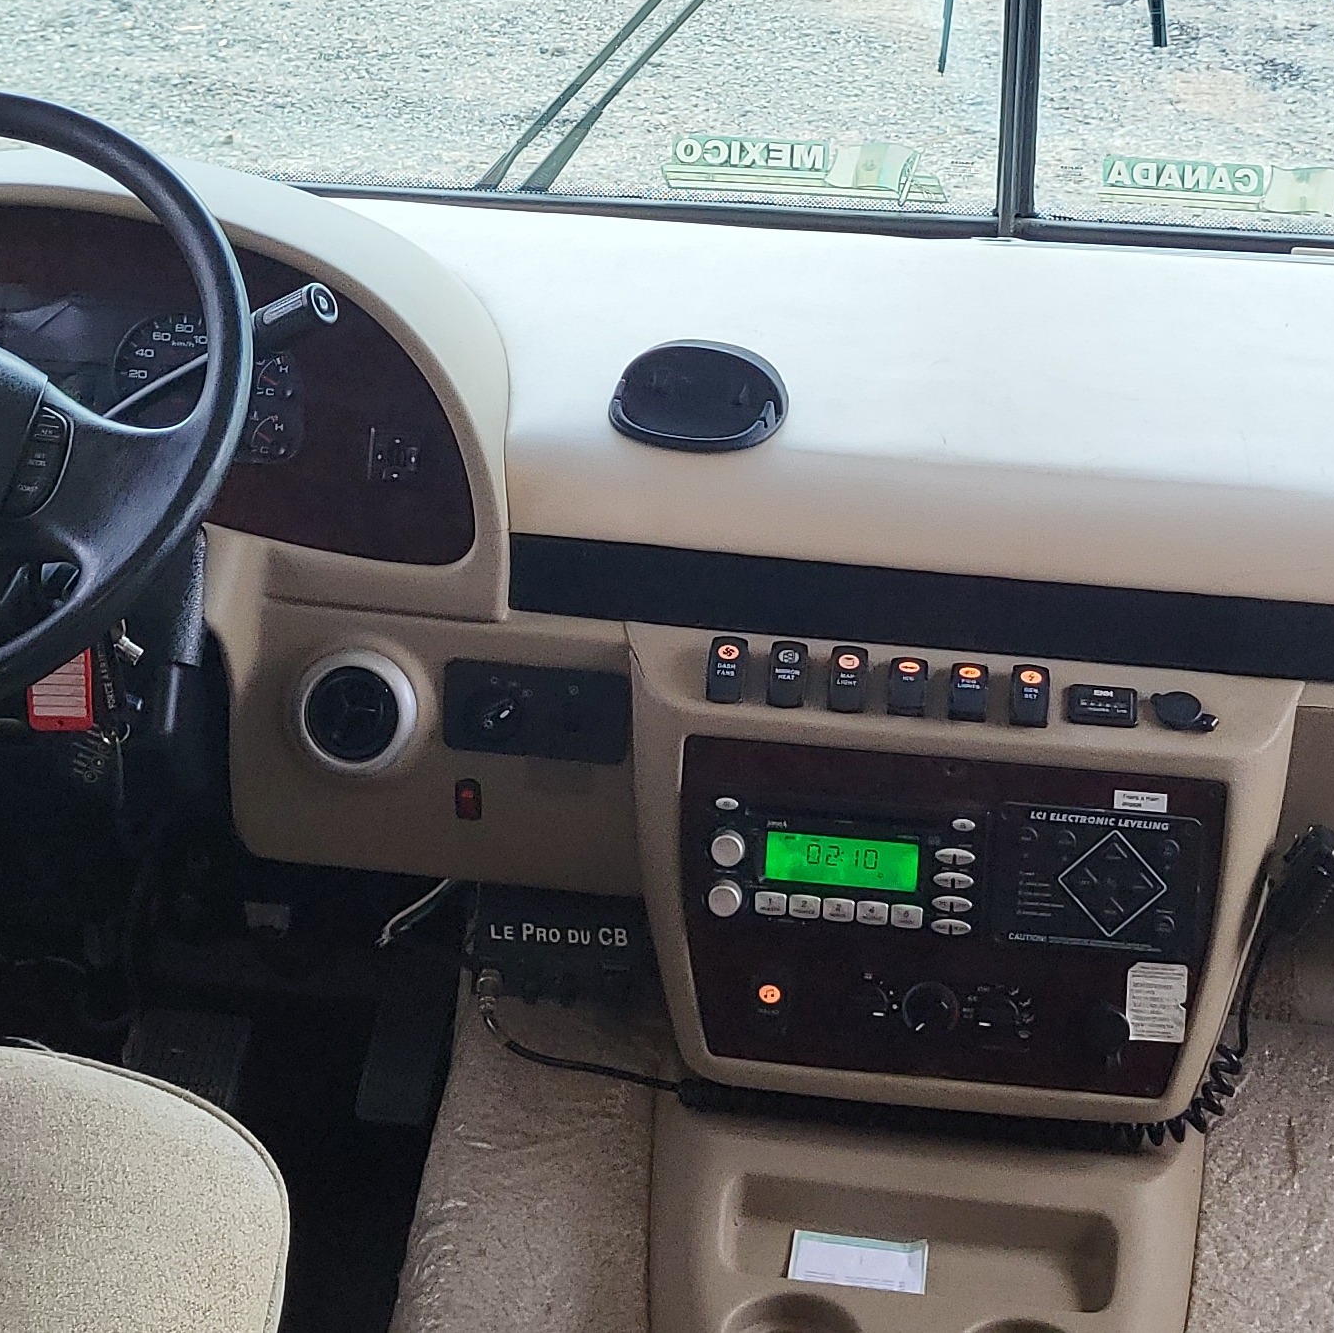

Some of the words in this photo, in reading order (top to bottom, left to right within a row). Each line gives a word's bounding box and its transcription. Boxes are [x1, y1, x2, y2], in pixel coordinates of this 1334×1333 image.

[135, 348, 155, 358] 40
[128, 368, 148, 379] 20
[716, 669, 735, 677] FANS
[1049, 812, 1116, 826] ELECTRONIC
[1117, 818, 1170, 831] LEVELING
[806, 843, 879, 870] 02:10
[489, 923, 515, 941] LE
[567, 928, 592, 946] DU
[598, 927, 629, 947] CB
